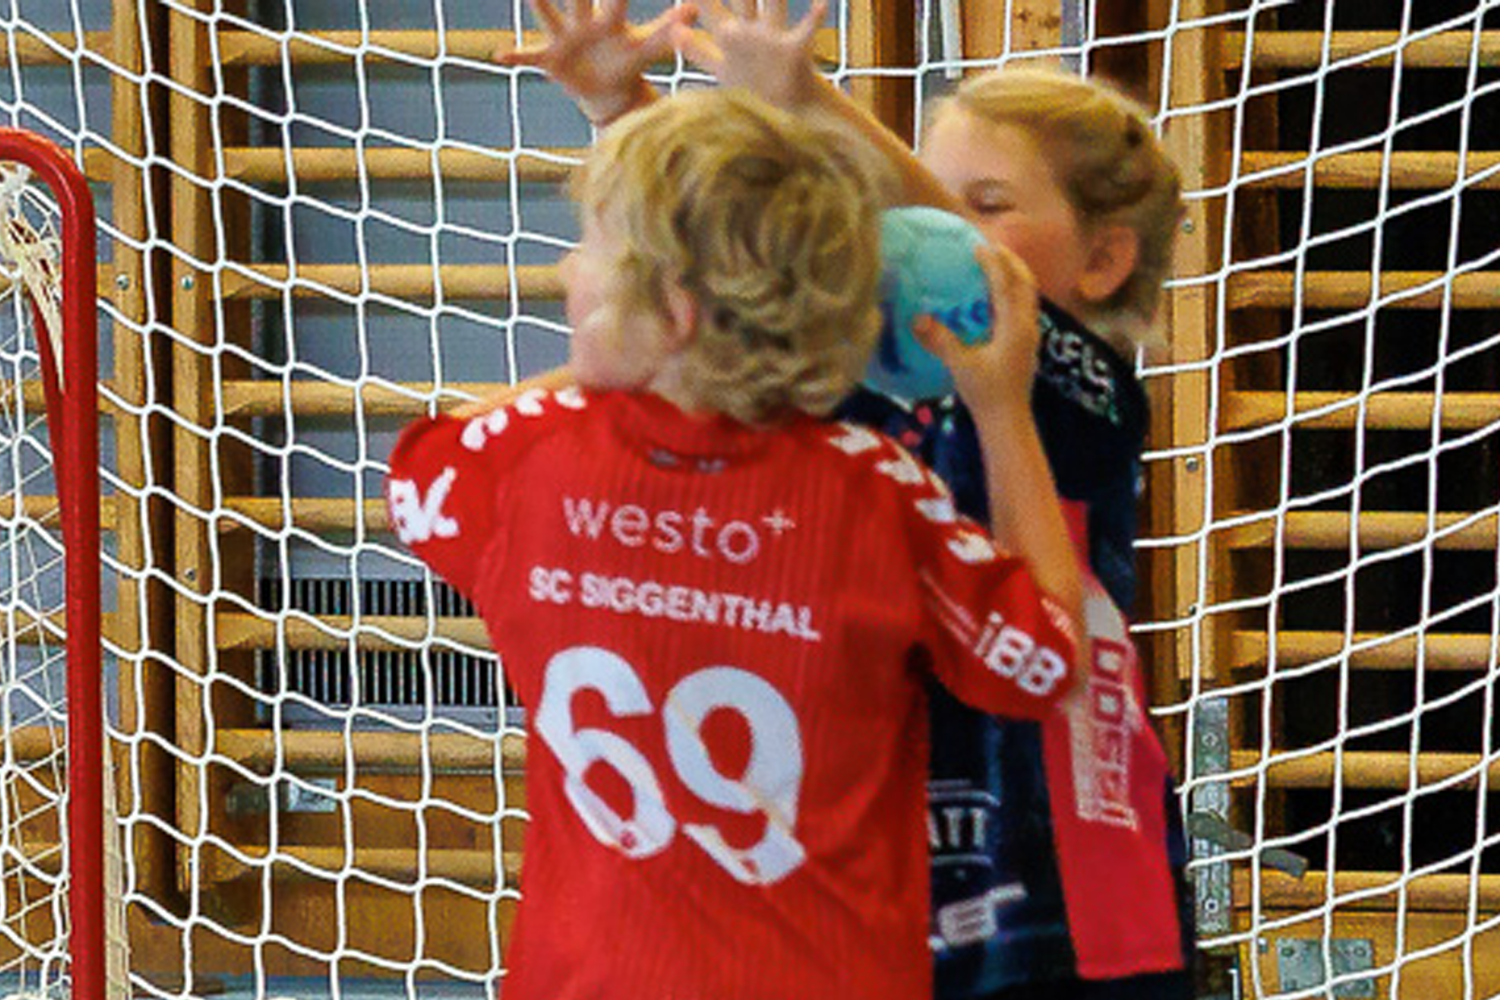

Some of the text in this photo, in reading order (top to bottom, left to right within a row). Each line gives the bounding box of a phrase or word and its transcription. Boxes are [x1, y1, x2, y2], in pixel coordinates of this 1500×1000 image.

[529, 565, 822, 641] SC SIGGENTHAL
[534, 645, 807, 888] 69
